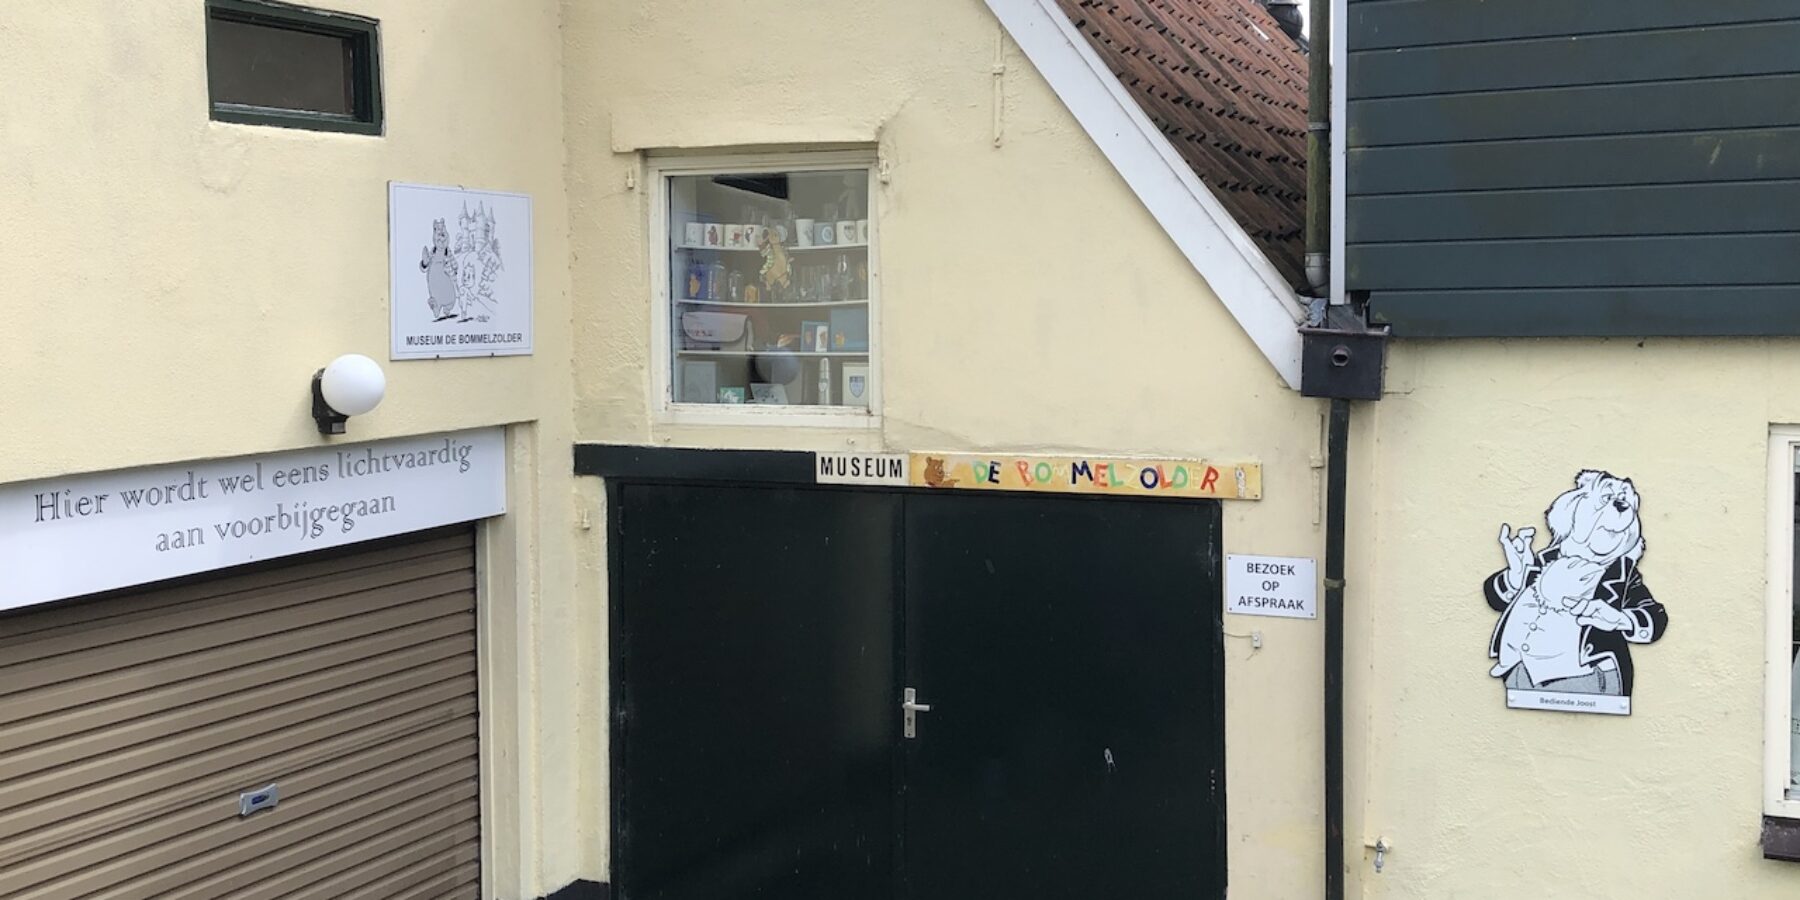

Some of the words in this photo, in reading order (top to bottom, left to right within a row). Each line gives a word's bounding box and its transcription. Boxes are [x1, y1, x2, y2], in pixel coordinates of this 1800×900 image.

[406, 336, 443, 345] MUSEUM
[445, 334, 456, 345] DE
[459, 332, 522, 344] BOMMELZOLDER
[35, 490, 109, 522] Hier
[120, 471, 209, 508] wordt
[219, 463, 264, 494] wel
[273, 463, 329, 488] eens
[337, 439, 473, 478] lichtvaardig
[820, 457, 903, 480] MUSEUM
[973, 461, 1001, 484] DE
[1017, 460, 1219, 494] BOMMELZOLDER
[156, 526, 204, 552] aan
[214, 493, 395, 540] voorbijgegaan
[1246, 563, 1295, 575] BEZOEK
[1262, 580, 1279, 591] OP
[1239, 596, 1303, 610] AFSPRAAK
[1540, 697, 1574, 706] Bediende
[1576, 699, 1596, 707] Joost
